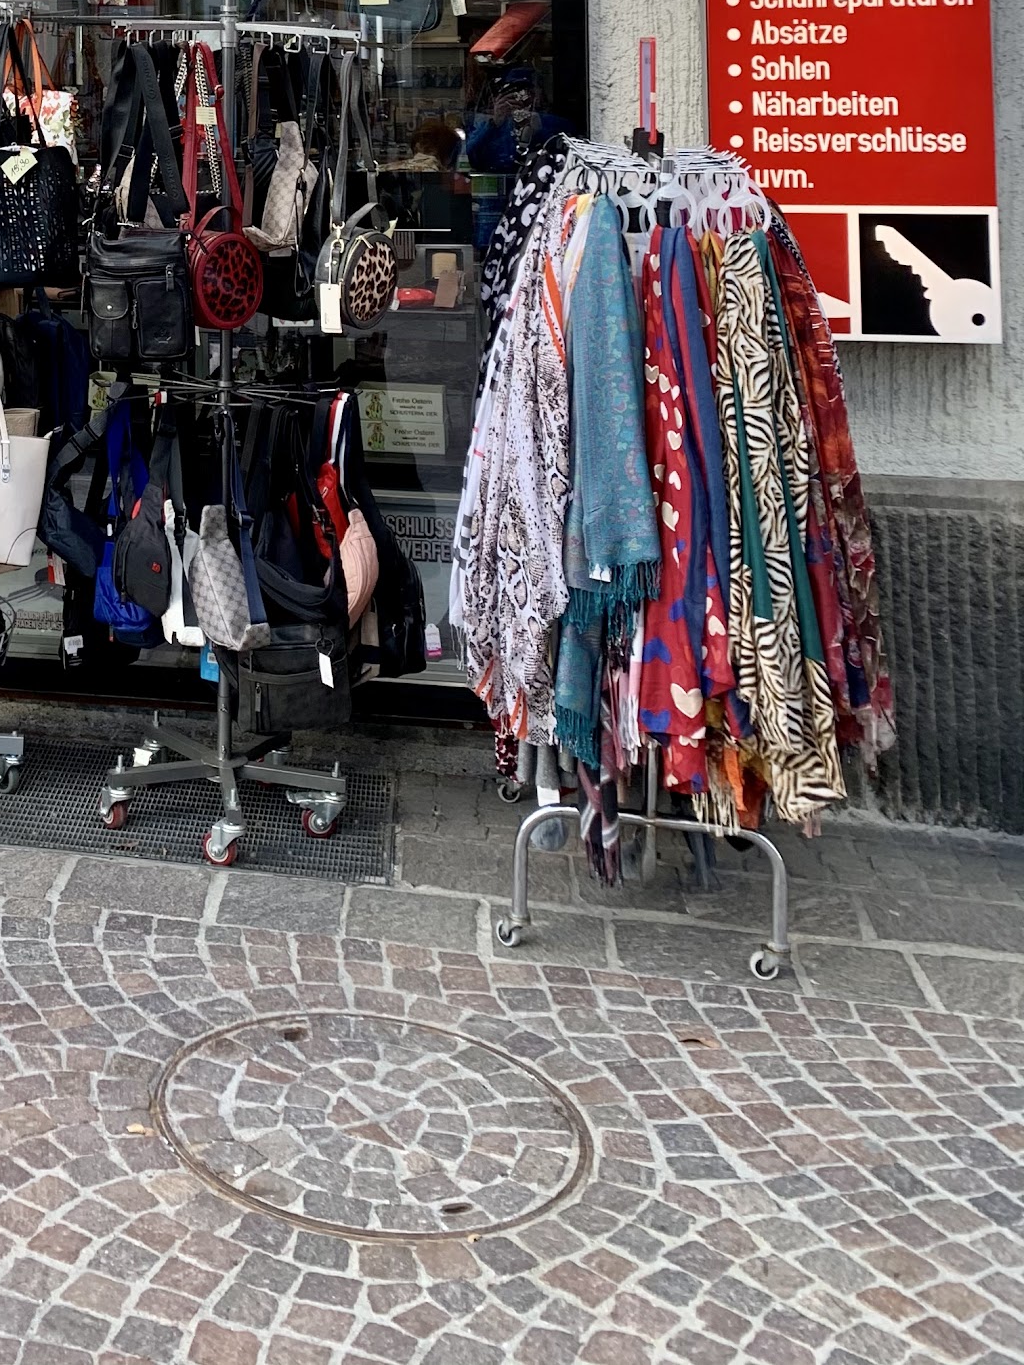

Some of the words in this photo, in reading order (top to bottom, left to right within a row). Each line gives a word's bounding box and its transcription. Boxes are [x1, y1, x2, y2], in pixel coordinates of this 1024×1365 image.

[751, 19, 849, 46] Absätze
[751, 55, 831, 82] Sohlen
[752, 90, 899, 118] Näharbeiten
[753, 127, 967, 154] Reissverschlüsse
[754, 166, 815, 190] uvm.
